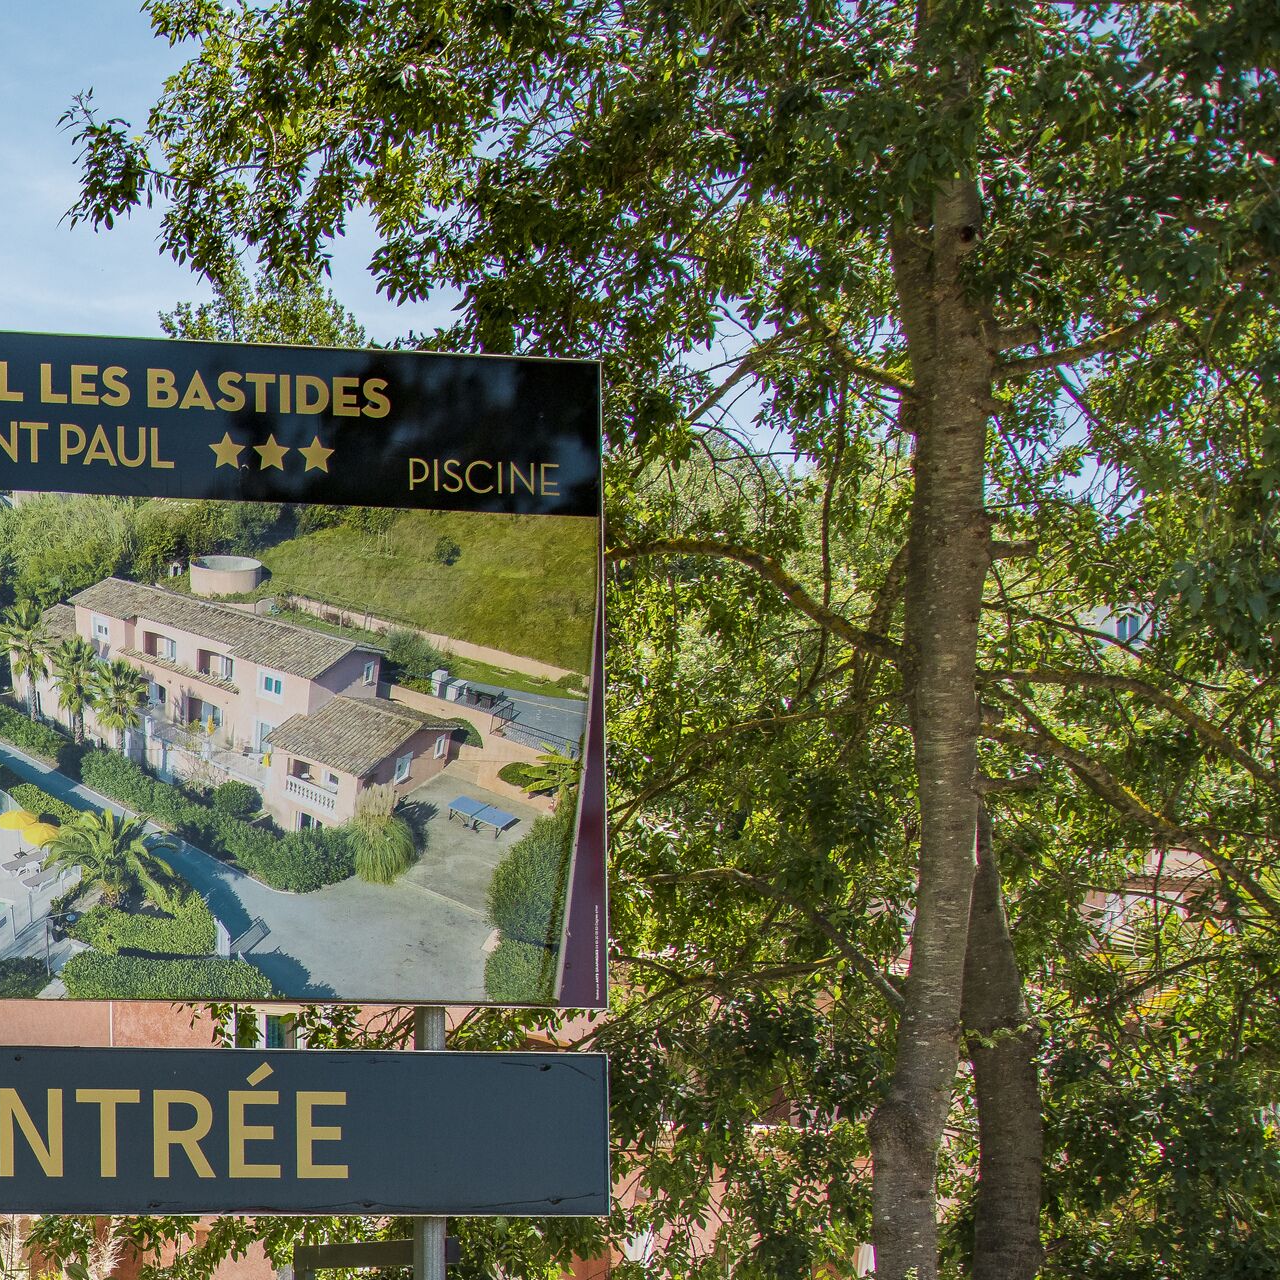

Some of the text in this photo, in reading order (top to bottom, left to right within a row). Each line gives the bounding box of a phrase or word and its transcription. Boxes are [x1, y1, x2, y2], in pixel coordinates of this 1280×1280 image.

[40, 363, 131, 407] LES
[147, 368, 392, 420] BASTIDES
[60, 423, 176, 469] PAUL
[408, 457, 560, 497] PISCINE
